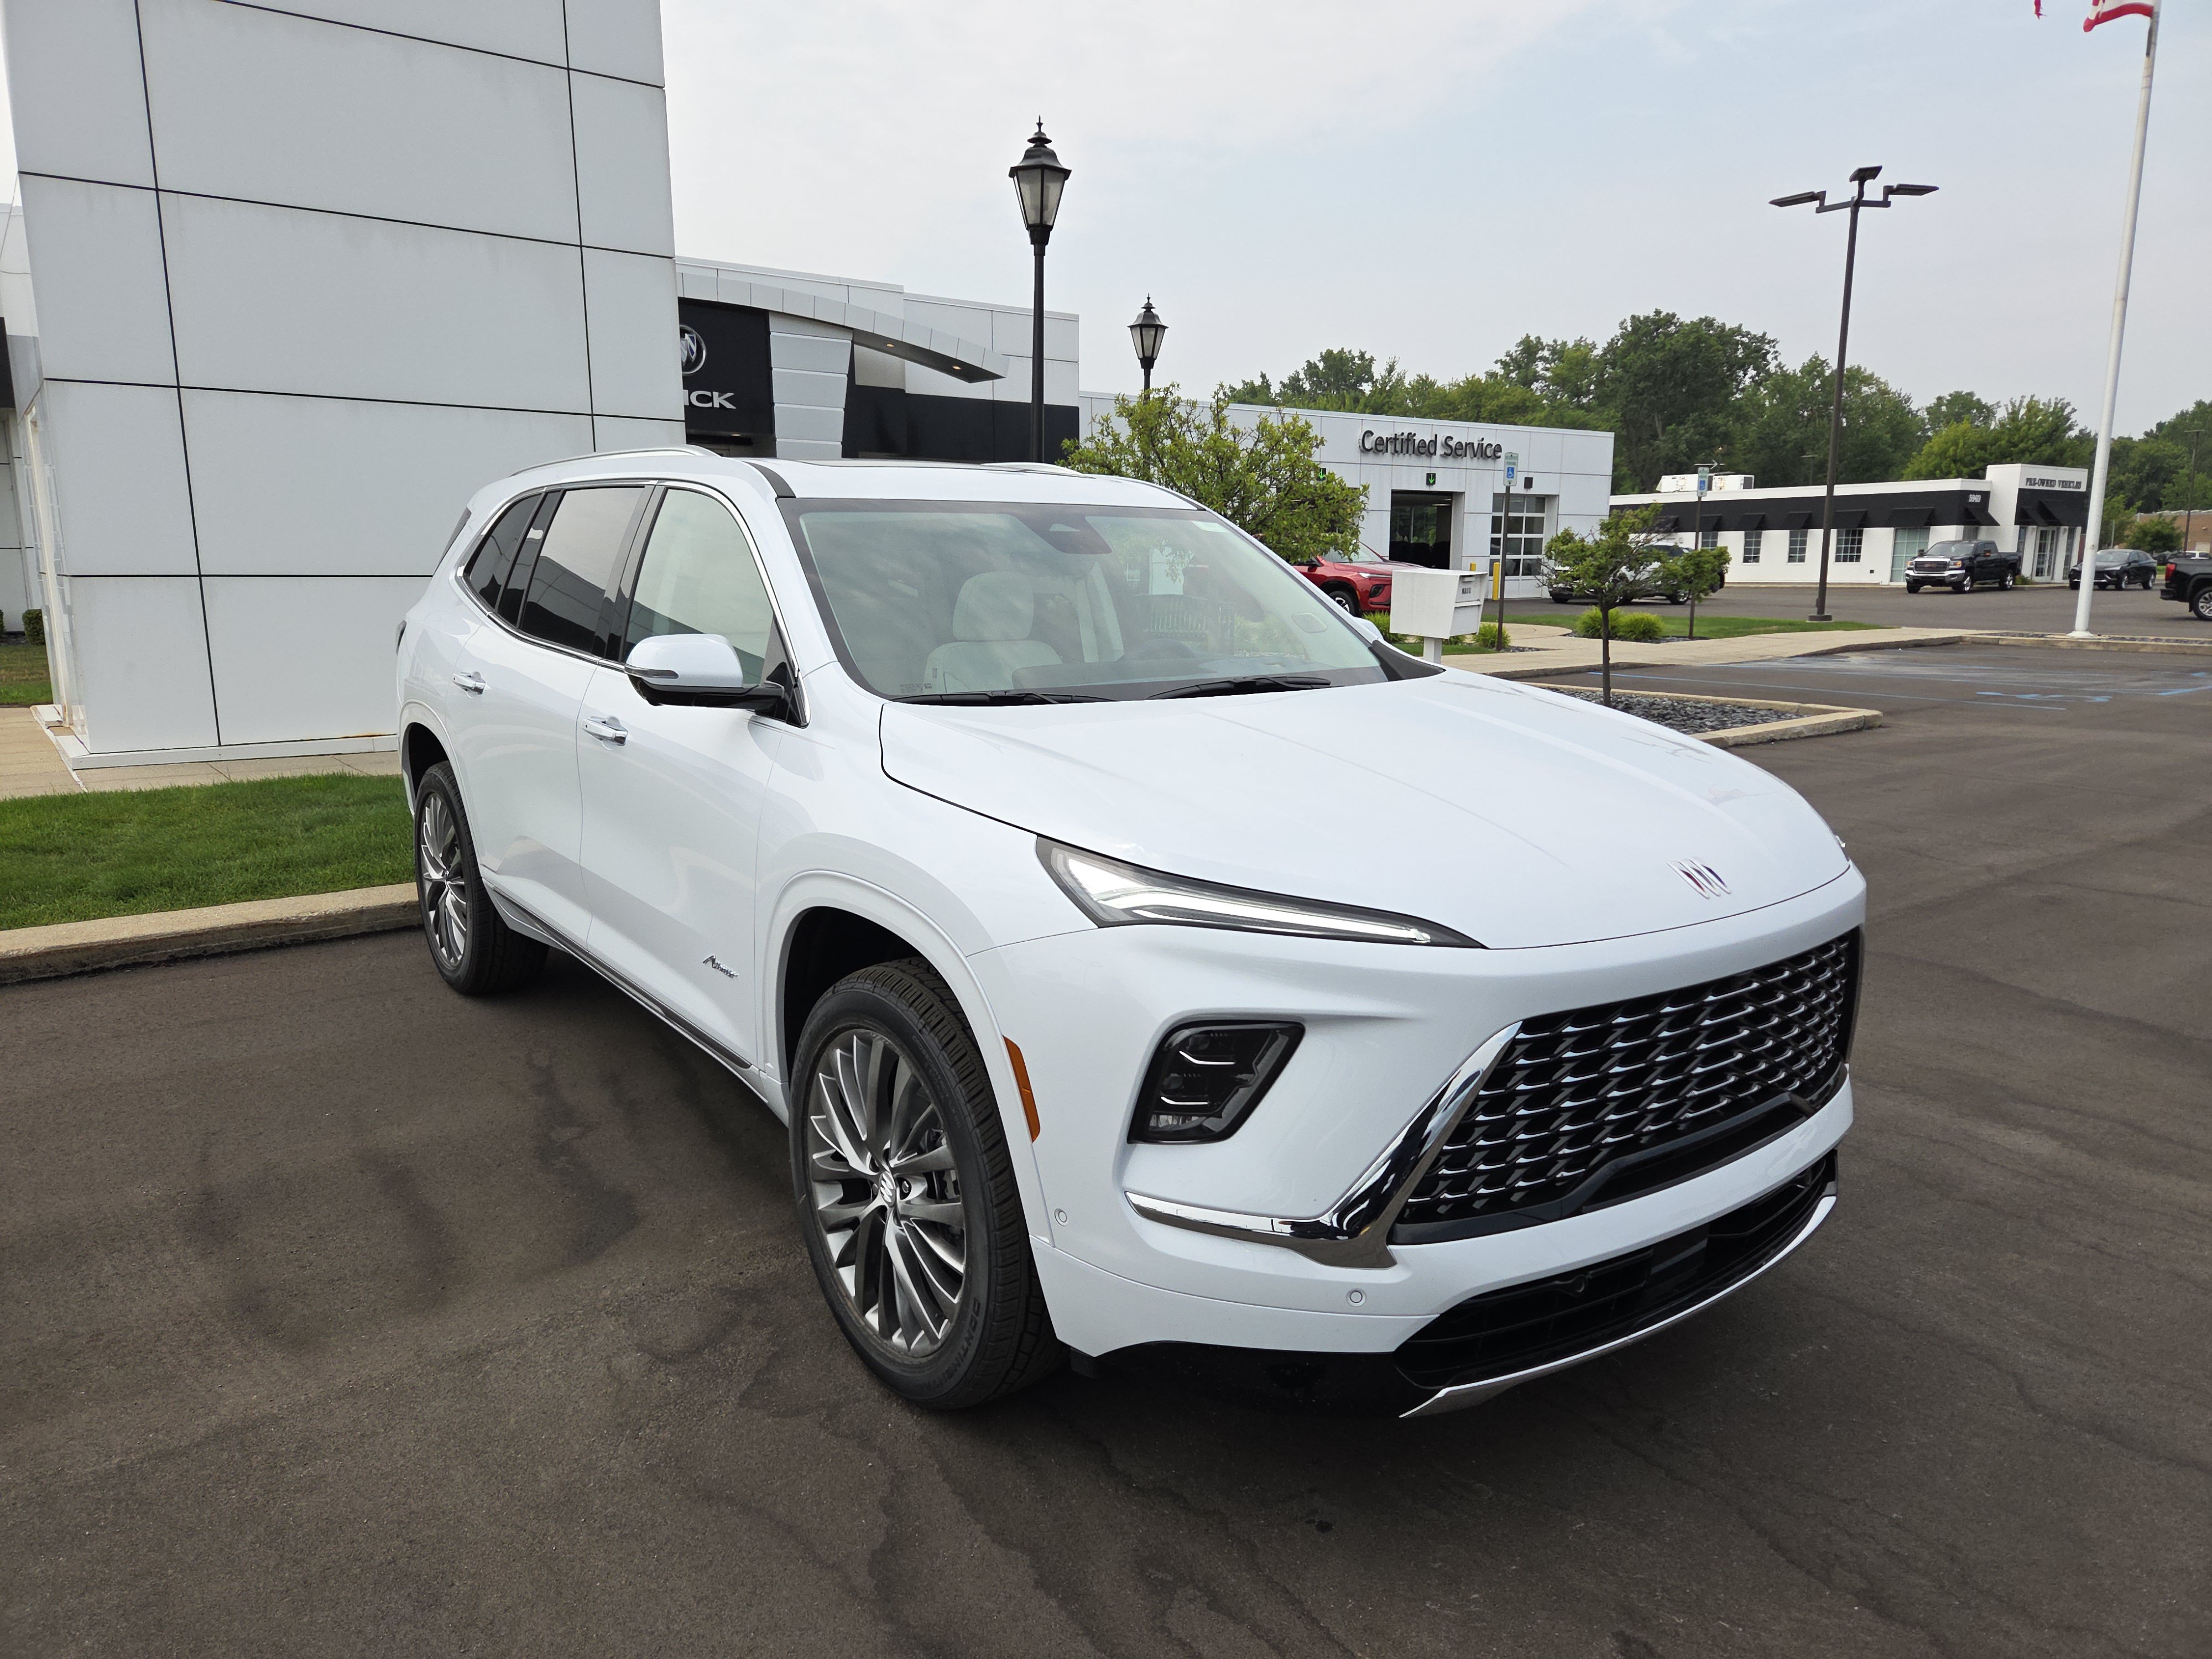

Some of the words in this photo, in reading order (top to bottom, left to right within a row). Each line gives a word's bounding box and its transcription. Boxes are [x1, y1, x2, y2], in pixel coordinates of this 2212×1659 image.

[1360, 429, 1438, 456] Certified
[1441, 435, 1503, 460] Service
[2025, 477, 2057, 488] PRE-OWNED
[2058, 479, 2082, 489] VEHICLES
